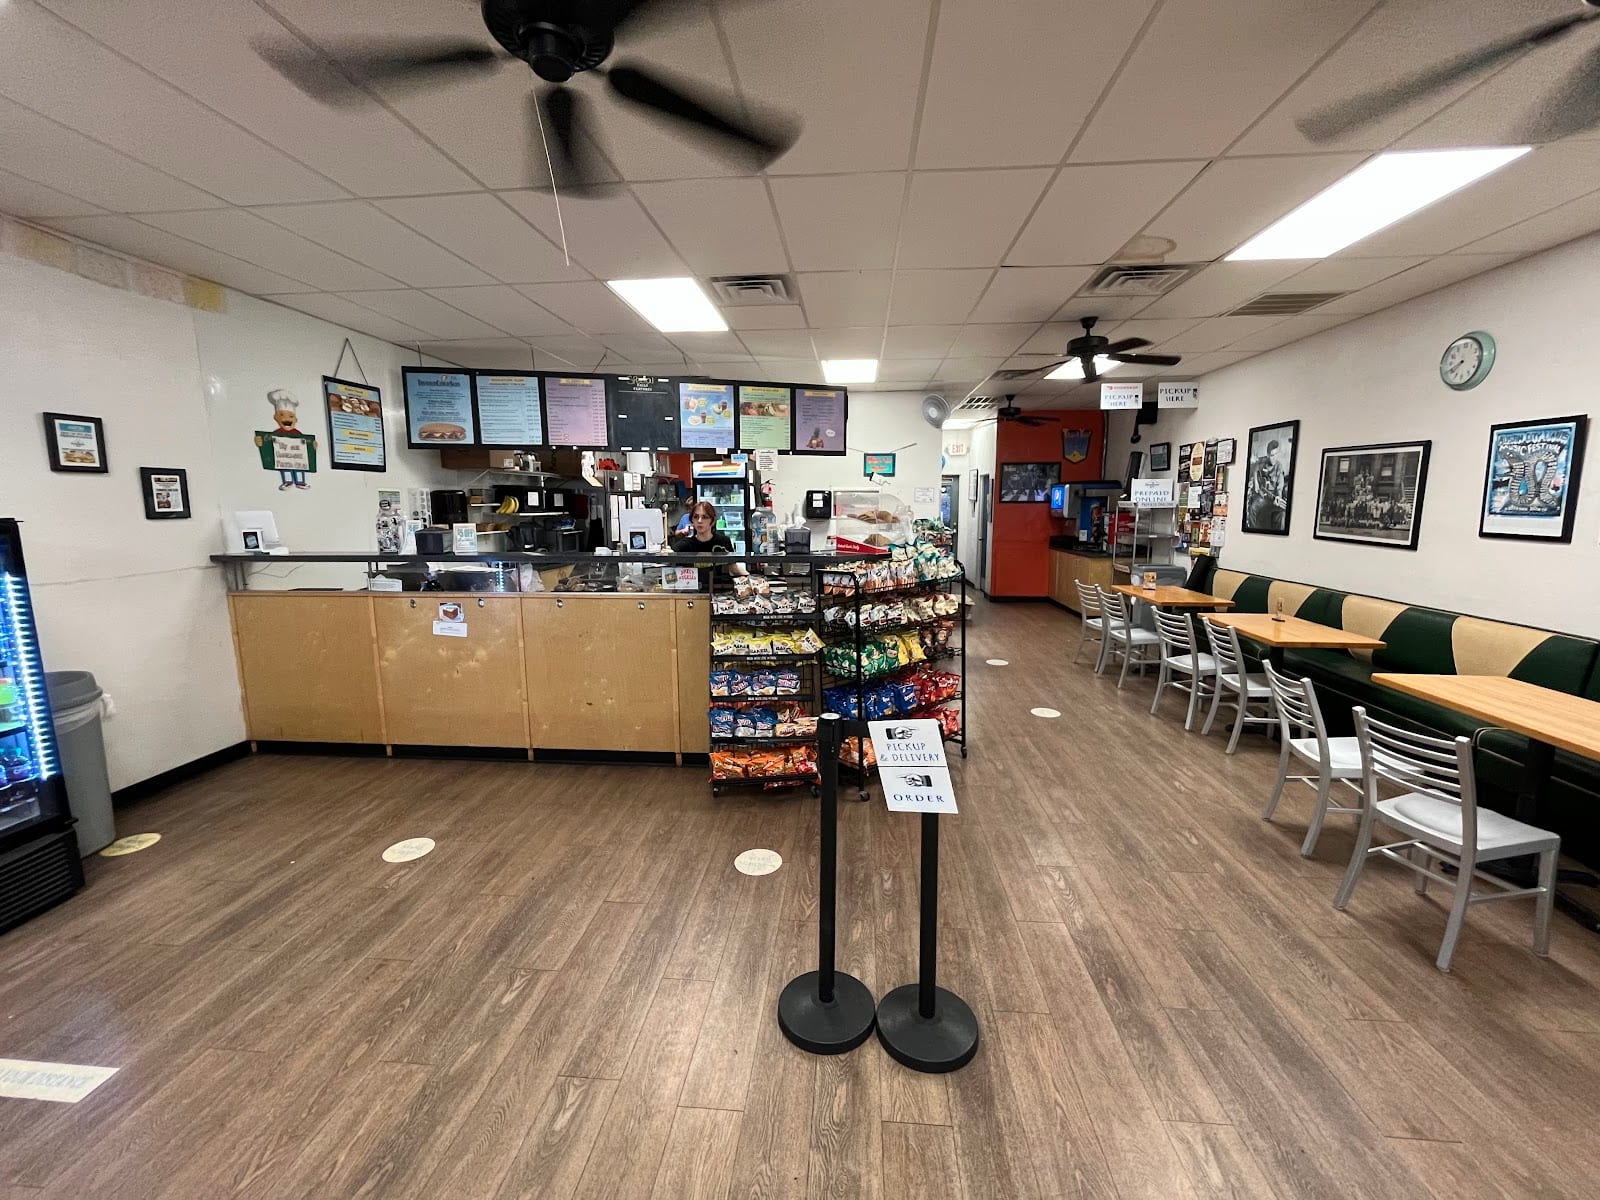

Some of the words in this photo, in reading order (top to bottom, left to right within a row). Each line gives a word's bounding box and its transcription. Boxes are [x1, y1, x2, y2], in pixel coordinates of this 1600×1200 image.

[950, 443, 960, 451] EXIT
[1499, 443, 1527, 455] MUSIC
[1528, 443, 1561, 454] FESTIVAL
[886, 742, 926, 751] PICKUP
[880, 754, 888, 762] &
[892, 753, 939, 762] DELIVERY
[893, 794, 945, 803] ORDER
